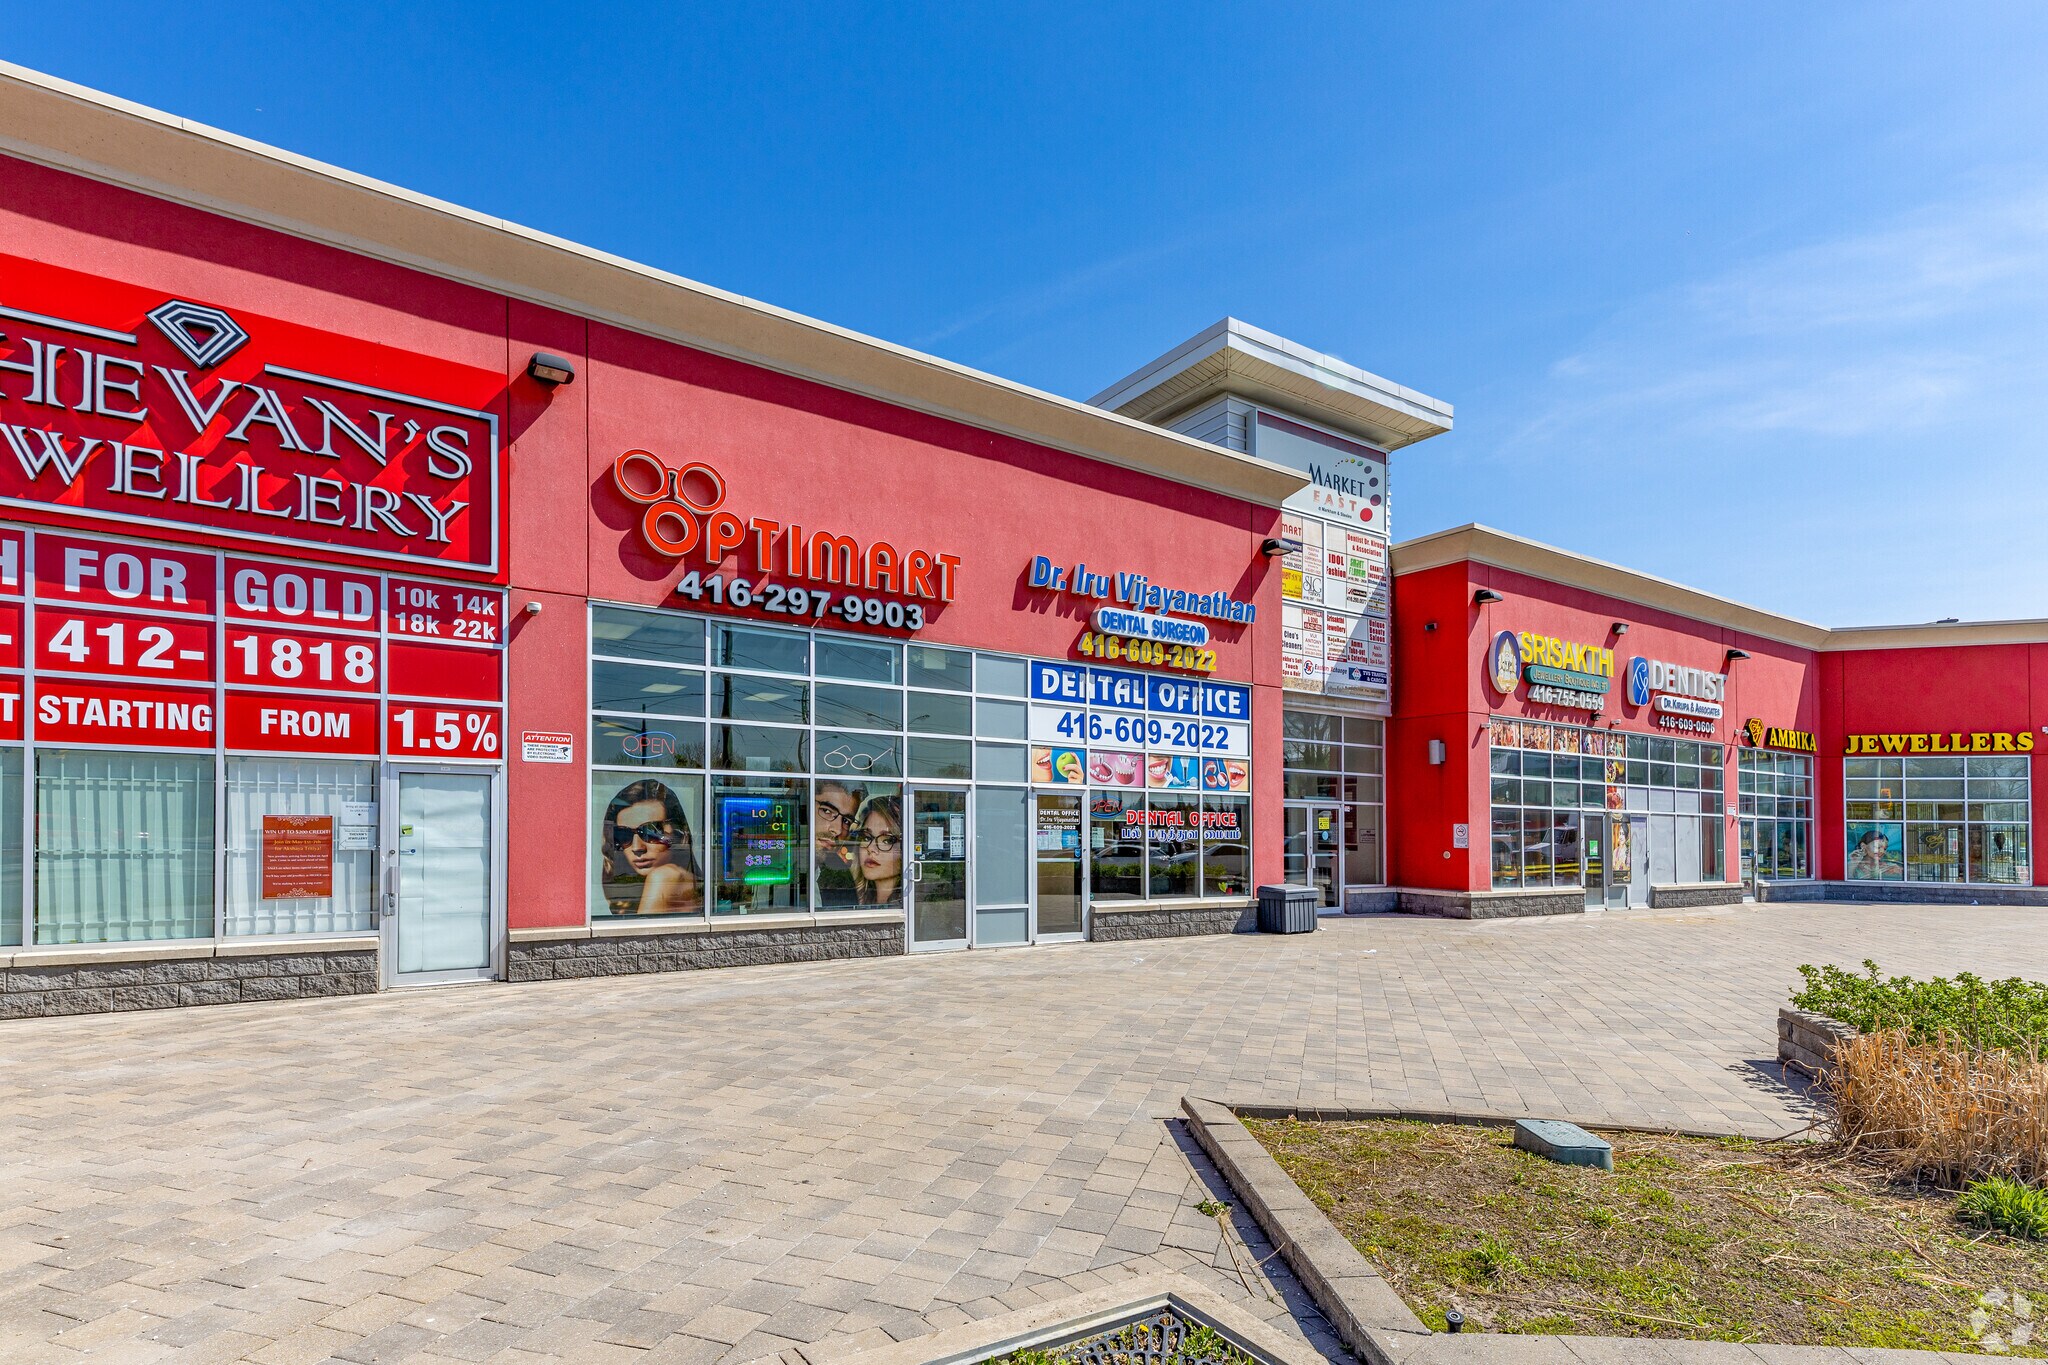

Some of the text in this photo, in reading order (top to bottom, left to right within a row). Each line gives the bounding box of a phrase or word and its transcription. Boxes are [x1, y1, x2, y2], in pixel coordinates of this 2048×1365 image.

[1308, 462, 1365, 498] MARKET
[1313, 489, 1357, 512] EAST
[642, 500, 962, 602] OPTIMART
[1328, 553, 1344, 566] IDOL
[64, 547, 189, 605] FOR
[234, 569, 374, 622] GOLD
[677, 570, 925, 630] 416-297-9903
[1029, 555, 1257, 624] Dr. Iru Vijayanathan
[1101, 610, 1206, 645] DENTAL SURGEON
[48, 619, 375, 685] 412- 1818
[1079, 631, 1217, 671] 416-609-2022
[1518, 631, 1615, 678] SRISAKTHI
[1041, 668, 1242, 714] DENTAL OFFICE
[1531, 684, 1605, 711] 416-755-0559
[1650, 660, 1726, 702] DENTIST
[38, 694, 214, 733] STARTING
[260, 708, 351, 739] FROM
[393, 708, 498, 754] 1.5%
[1057, 712, 1229, 750] 416-609-2022
[1659, 714, 1716, 734] 416-609-0606
[1768, 727, 1818, 753] AMBIKA
[623, 735, 675, 754] OPEN
[1845, 732, 2035, 755] JEWELLERS
[1126, 809, 1237, 828] DENTAL OFFICE
[745, 853, 772, 866] $35
